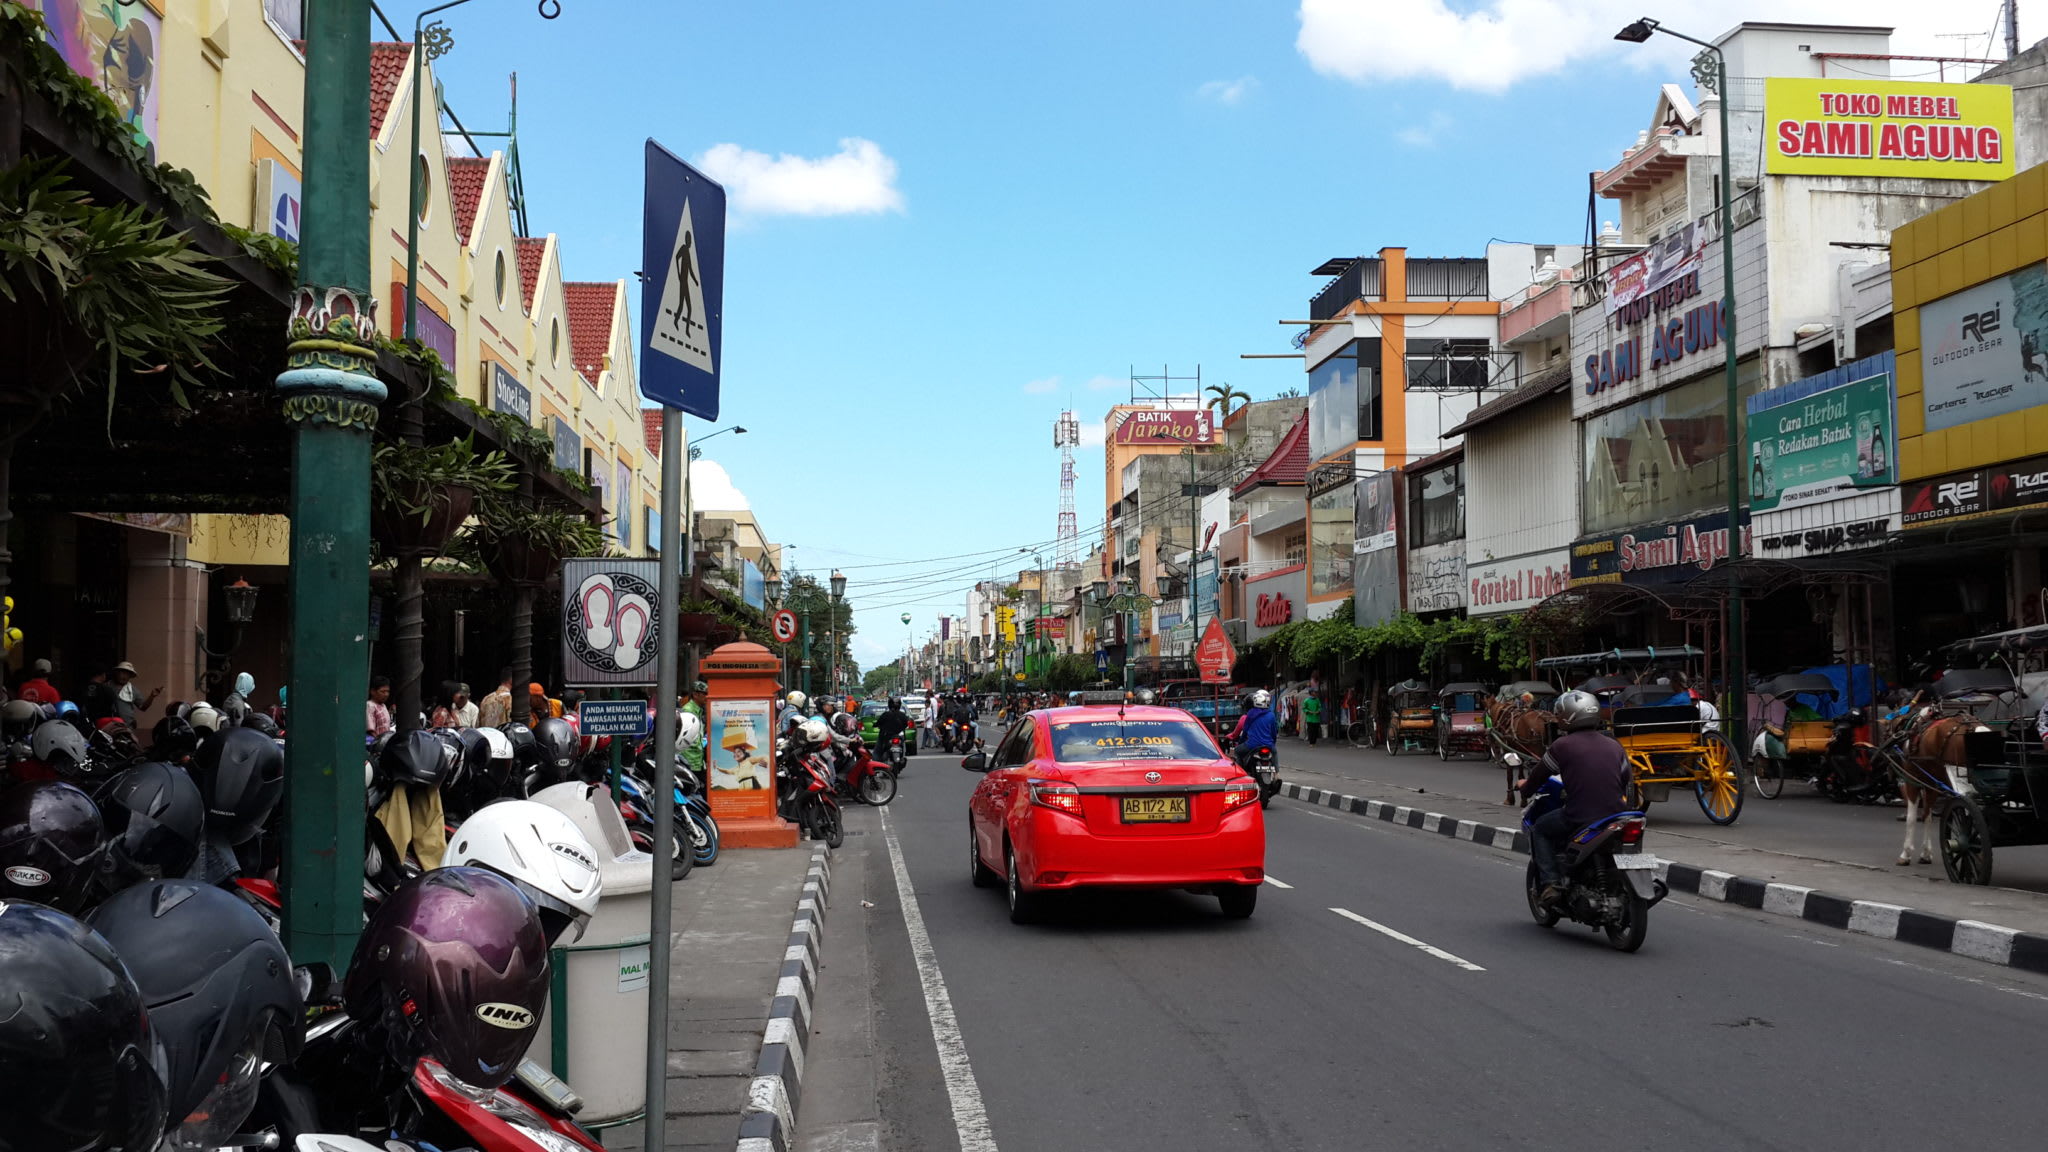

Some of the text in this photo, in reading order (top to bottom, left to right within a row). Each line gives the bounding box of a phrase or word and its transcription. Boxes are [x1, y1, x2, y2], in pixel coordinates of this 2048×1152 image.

[1819, 93, 1960, 119] TOKO MEBEL
[1778, 119, 2003, 163] SAMI AGUNG
[1653, 268, 1702, 314] MEBEL
[1962, 301, 2000, 342] Rei
[1932, 337, 2003, 366] OUTDOOR GEAR
[1585, 335, 1641, 395] SAMI
[496, 371, 531, 421] ShoeLine
[1928, 397, 1967, 413] Cartenz
[1137, 412, 1172, 422] BATIK
[1779, 416, 1802, 434] Cara
[1803, 393, 1848, 427] Herbal
[1123, 420, 1194, 443] Janoko
[1778, 436, 1820, 456] Redakan
[1821, 422, 1852, 446] Batuk
[1938, 473, 1980, 506] Rei
[1903, 508, 1951, 523] OUTDOOR
[1953, 502, 1981, 515] GEAR
[1761, 518, 1891, 552] TOKO OBAT SINAR SEHAT
[1619, 525, 1678, 573] Sami
[1255, 591, 1292, 628] Bata
[585, 705, 640, 714] ANDA MEMASUKI
[618, 714, 643, 722] RAMAH
[721, 709, 738, 717] EMS
[590, 723, 637, 732] PEJALAN KAKI
[1095, 736, 1172, 747] 412 000
[1125, 799, 1185, 813] AB 1172 AK
[555, 844, 592, 866] INK
[620, 964, 641, 976] MAL
[482, 1006, 530, 1023] INK
